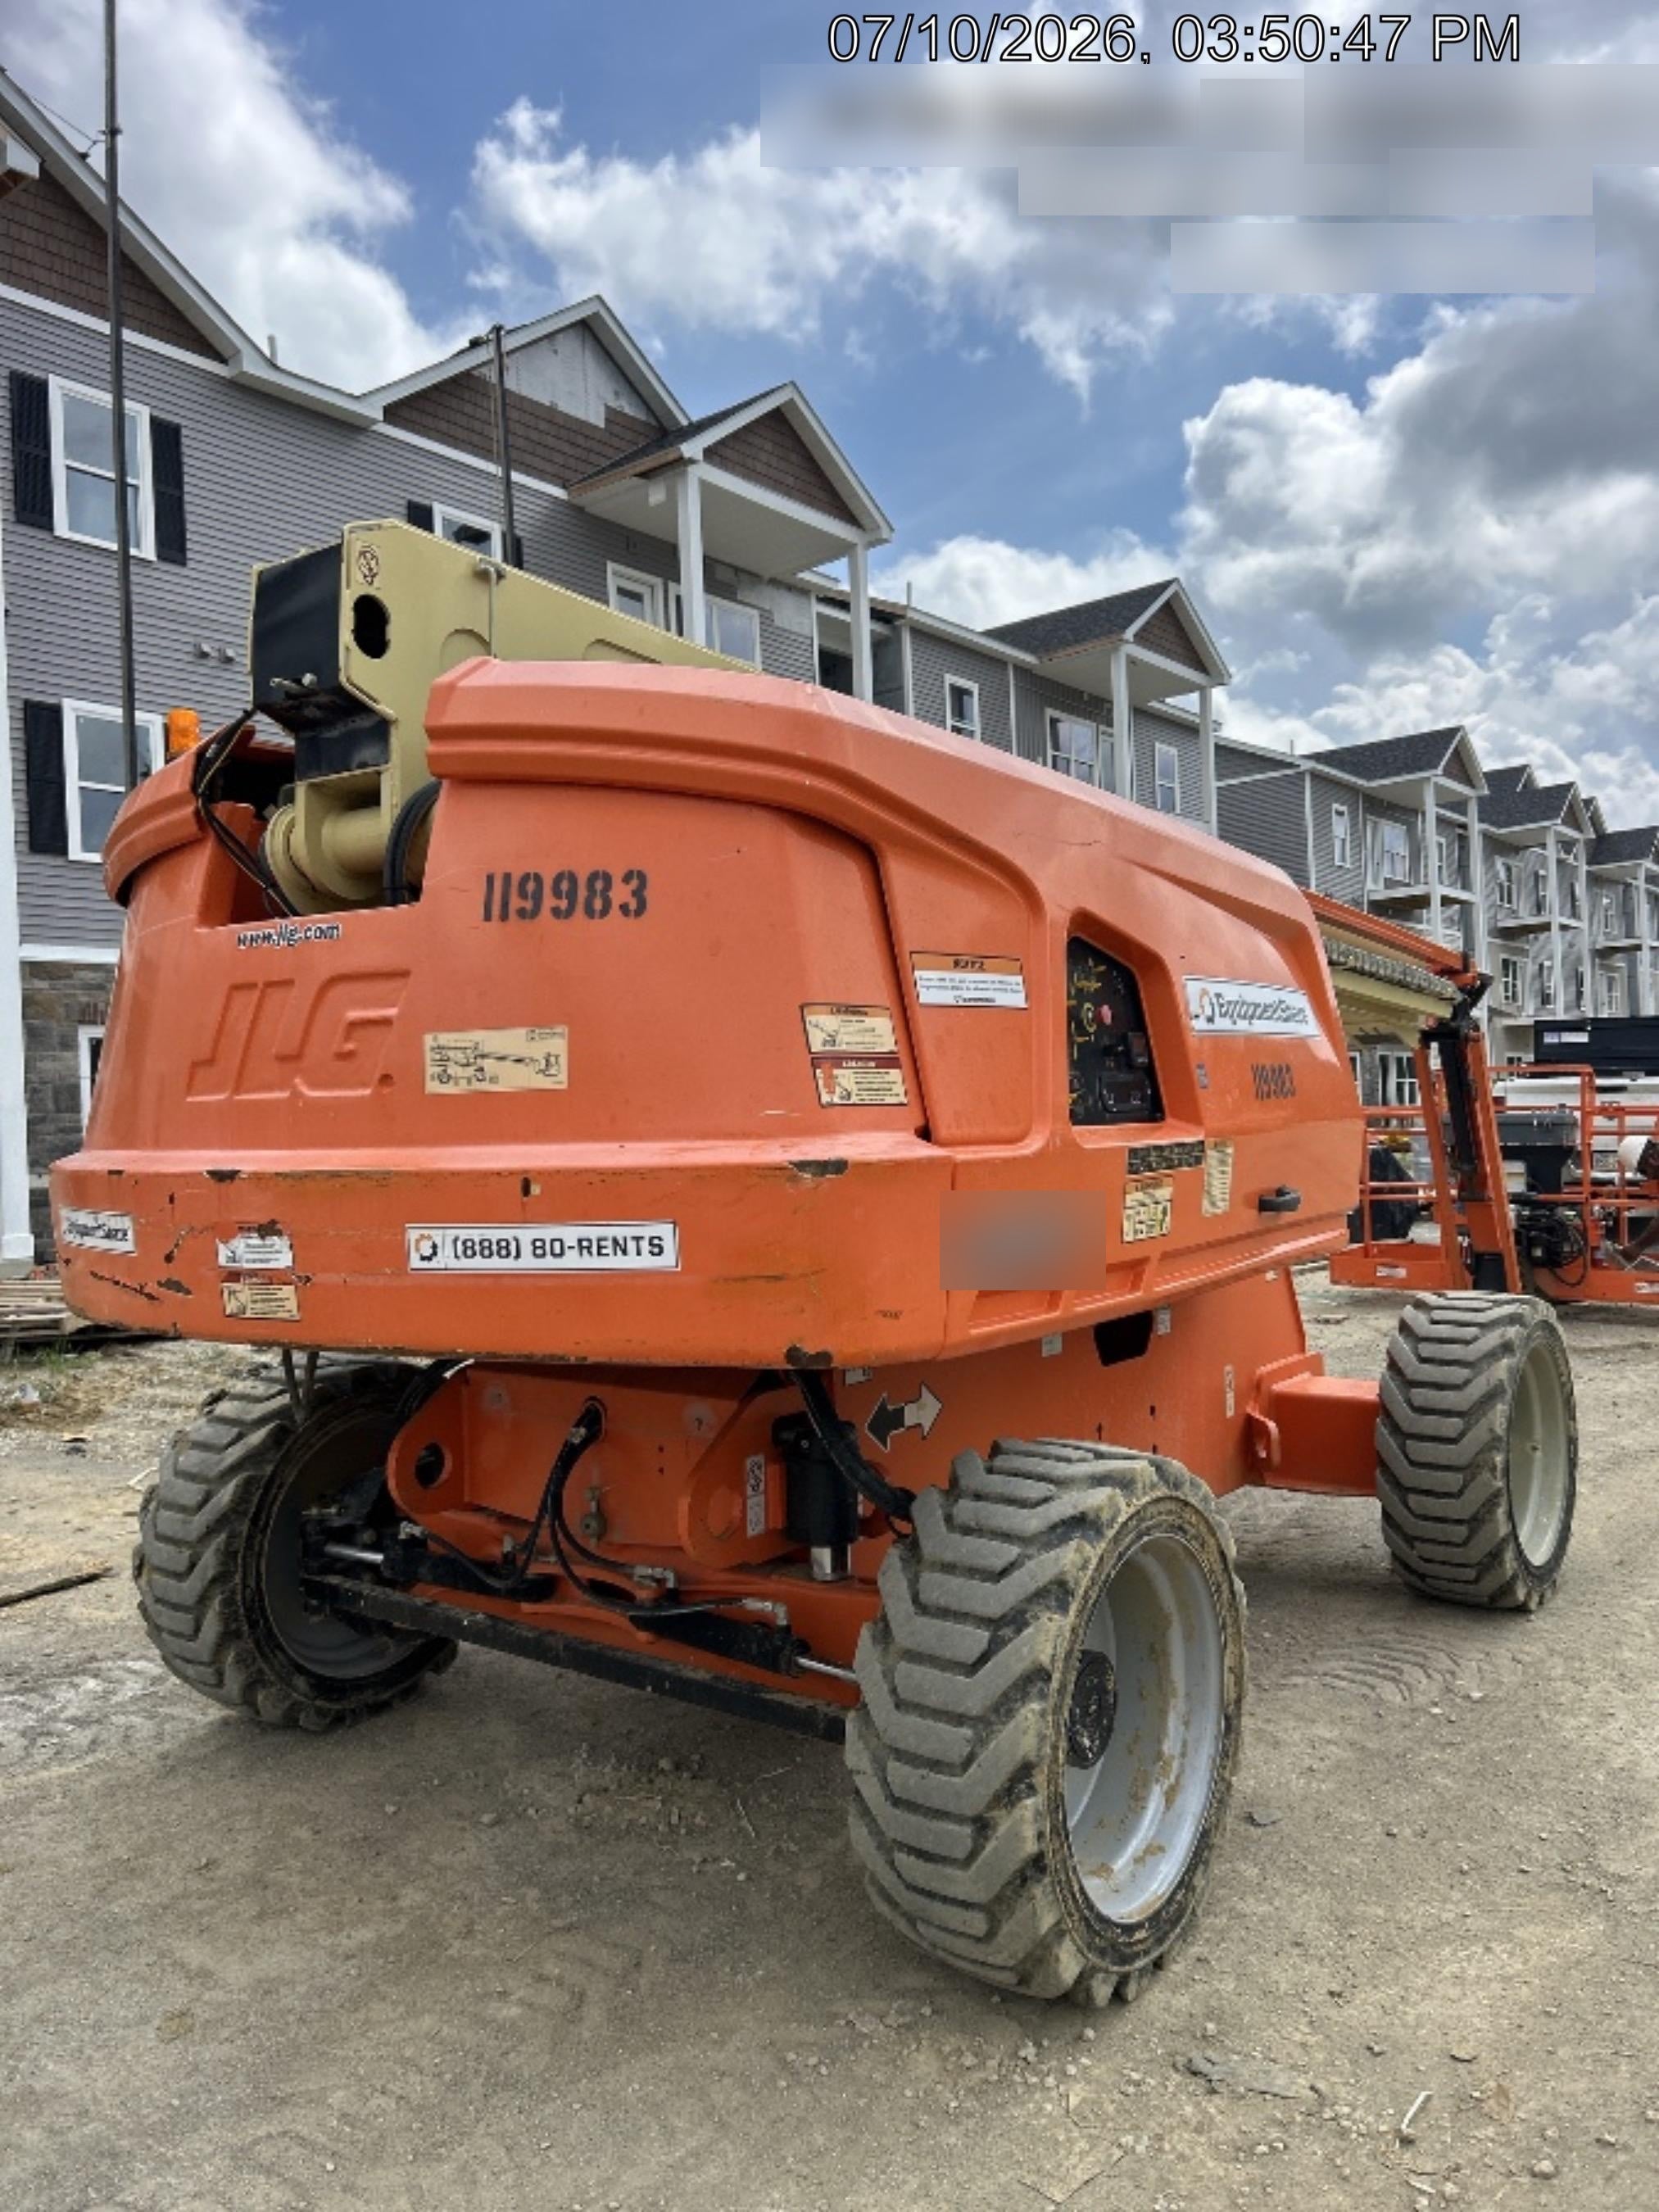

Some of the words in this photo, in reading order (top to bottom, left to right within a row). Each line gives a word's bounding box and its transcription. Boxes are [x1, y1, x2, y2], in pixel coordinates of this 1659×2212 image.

[483, 869, 648, 922] 119983
[237, 922, 341, 948] www.jlg.com
[186, 969, 412, 1101] JLG
[452, 1235, 522, 1262] (888)
[531, 1235, 664, 1260] 80-RENTS
